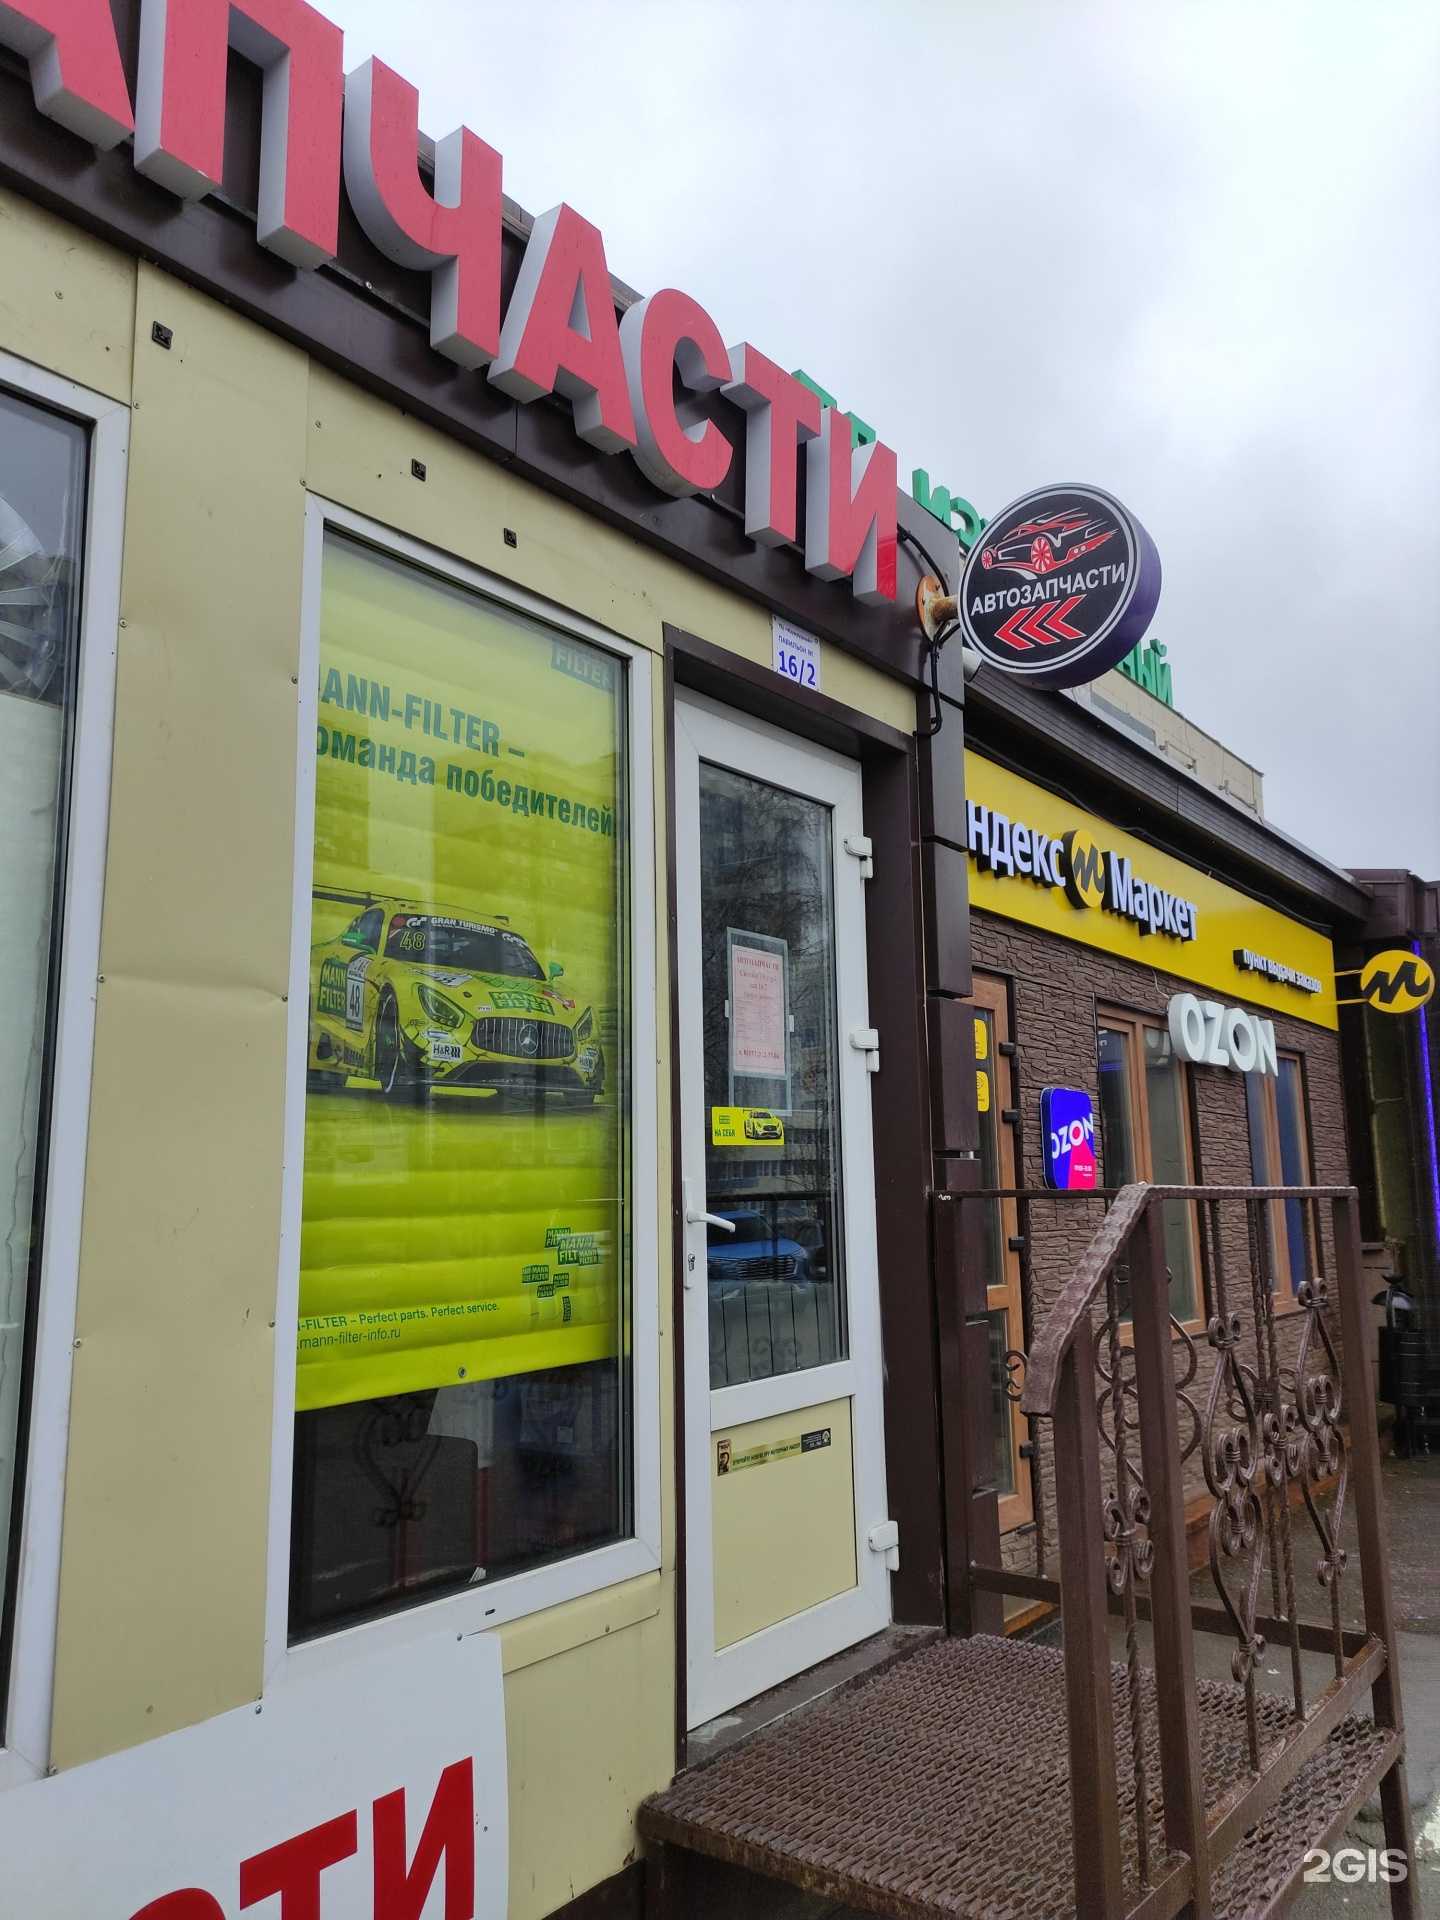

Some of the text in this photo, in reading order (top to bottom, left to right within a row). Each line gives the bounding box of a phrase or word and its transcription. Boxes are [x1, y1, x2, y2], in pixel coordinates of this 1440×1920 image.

[970, 563, 1125, 617] АВТОЗАПЧАСТИ
[779, 650, 816, 686] 16/2
[318, 664, 501, 757] ANN-FILTER
[446, 763, 613, 837] победителей
[1107, 850, 1198, 941] Маркет
[399, 930, 426, 951] 48
[431, 917, 457, 926] GRAN
[322, 963, 347, 989] MANN
[349, 985, 360, 1018] 48
[1168, 993, 1278, 1077] OZON
[1051, 1113, 1094, 1159] OZON
[359, 1312, 398, 1325] Perfect
[400, 1309, 429, 1323] parts.
[431, 1304, 465, 1317] Perfect
[466, 1302, 500, 1314] service.
[130, 1756, 476, 1920] ТИ
